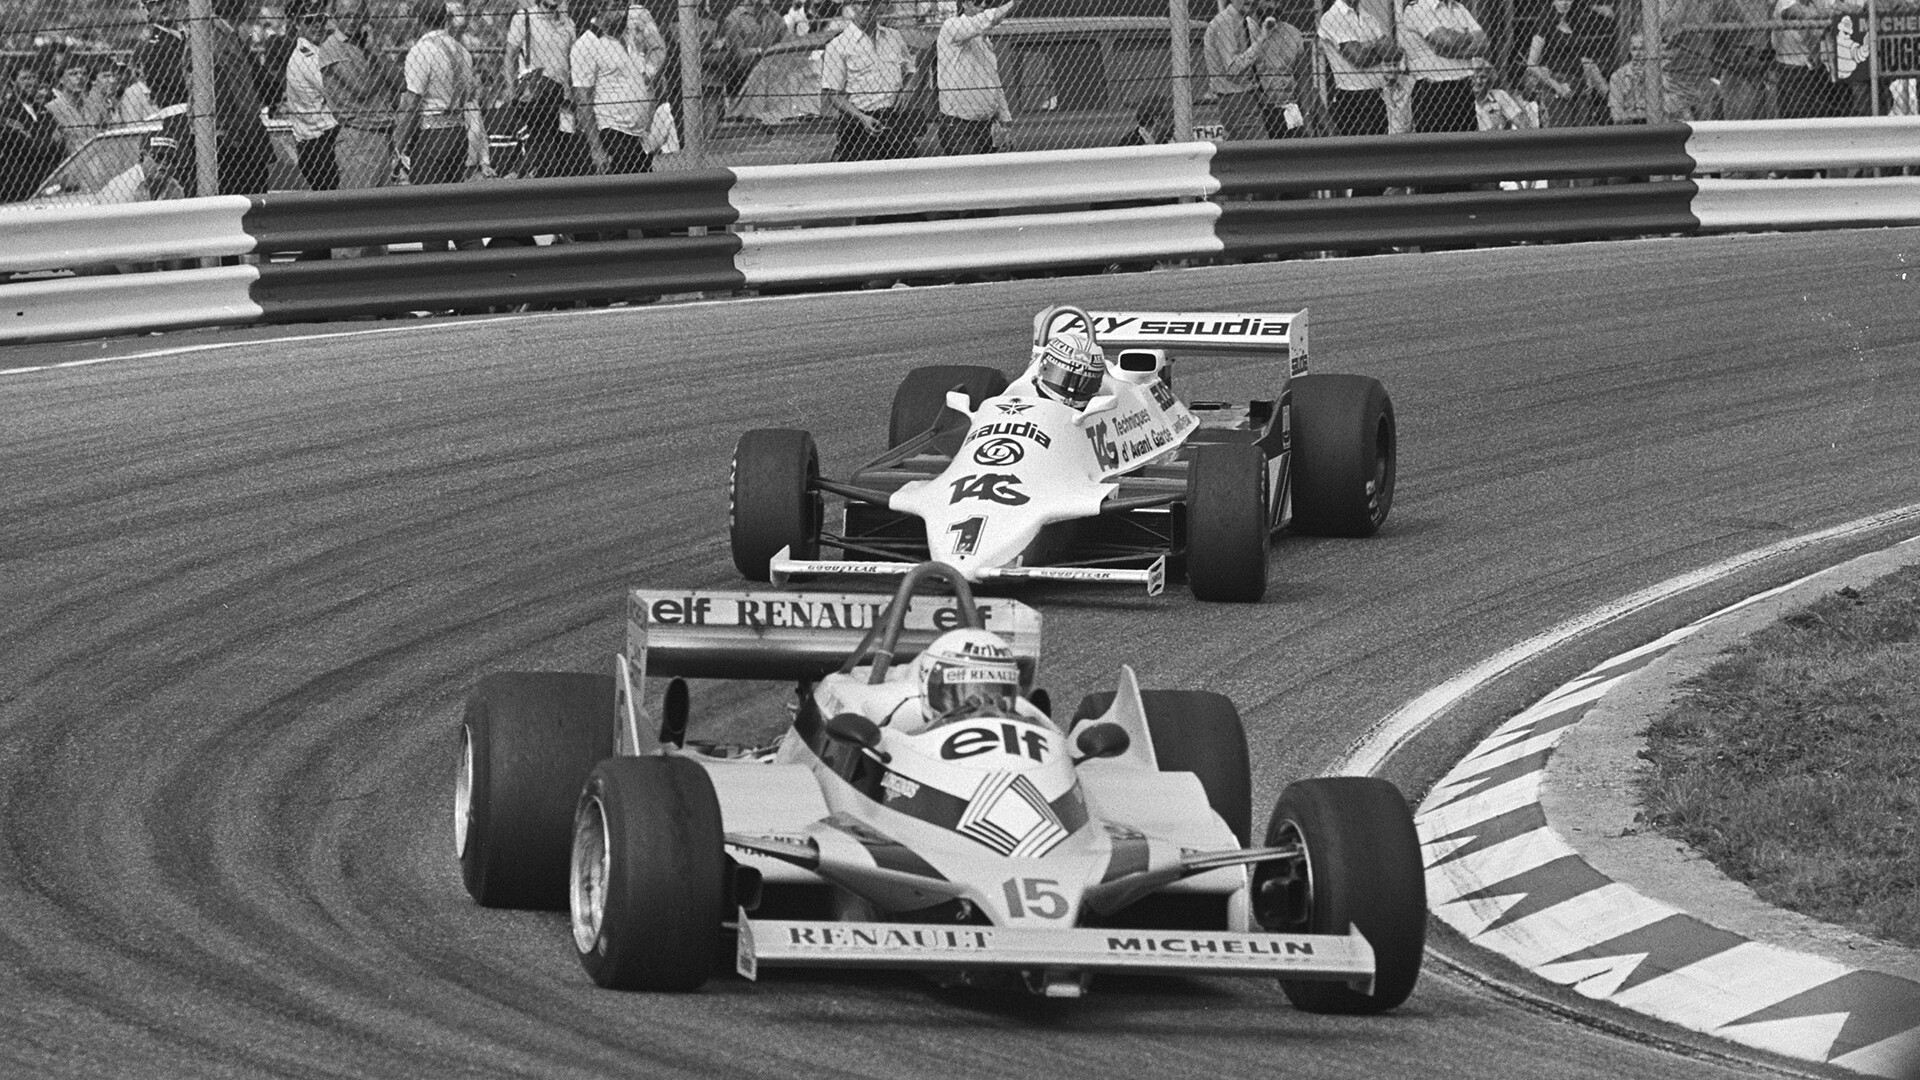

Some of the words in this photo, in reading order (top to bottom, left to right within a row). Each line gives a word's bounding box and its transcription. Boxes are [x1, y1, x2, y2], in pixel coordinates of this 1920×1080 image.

[1138, 319, 1290, 336] saudia
[964, 421, 1052, 450] saudia
[949, 473, 1031, 506] TAG
[948, 515, 987, 555] 1
[652, 597, 711, 625] elf
[933, 605, 992, 631] ef
[940, 723, 1050, 764] elf
[1002, 877, 1070, 920] 15
[789, 927, 993, 949] RENAULT
[1106, 937, 1315, 956] MICHELIN
